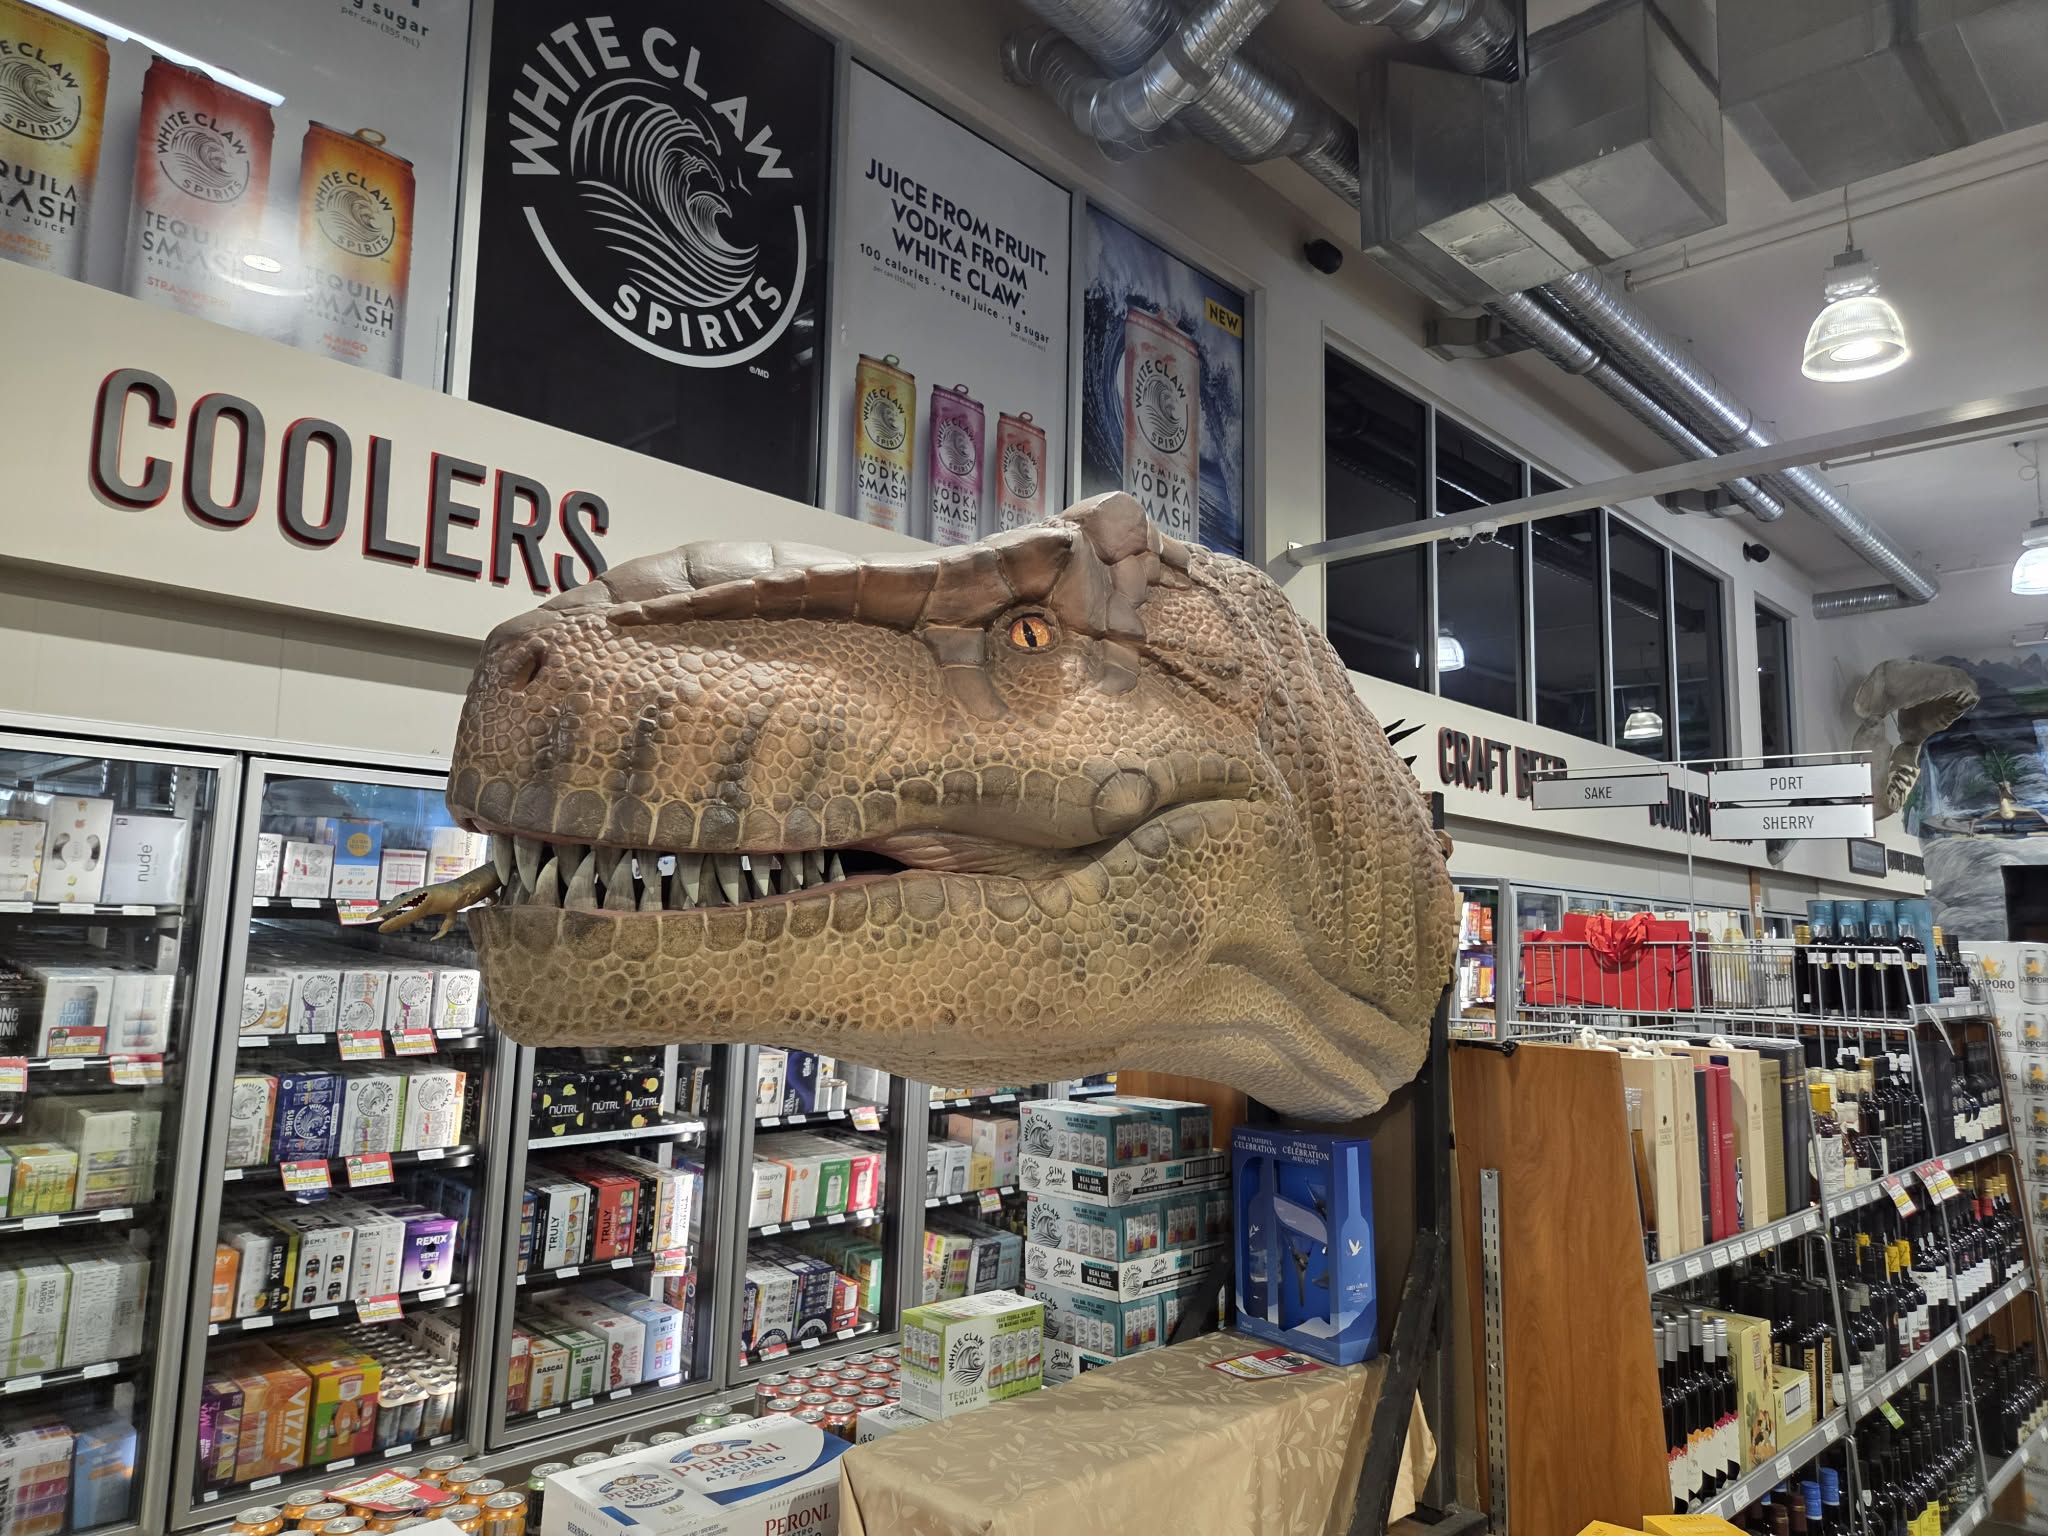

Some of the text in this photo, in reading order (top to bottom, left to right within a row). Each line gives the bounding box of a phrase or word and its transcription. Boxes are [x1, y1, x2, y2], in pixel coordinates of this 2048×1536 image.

[341, 6, 358, 17] per
[360, 16, 378, 27] can
[380, 23, 400, 38] (355
[372, 3, 430, 37] sugar
[16, 41, 79, 89] CLAW
[508, 15, 793, 178] WHITE CLAW
[3, 115, 73, 137] SPIRITS
[157, 111, 247, 155] WHITE CLAW
[182, 179, 243, 200] SPIRITS
[315, 171, 392, 213] WHITE CLAW
[23, 216, 66, 234] JUICE
[865, 158, 1049, 276] JUICE FROM FRUIT.
[336, 235, 390, 253] SPIRITS
[891, 198, 1028, 290] VODKA FROM
[892, 227, 962, 283] WHITE
[306, 265, 394, 310] TEQUILA
[859, 242, 881, 261] 100
[885, 256, 931, 286] calories
[950, 288, 970, 305] real
[973, 296, 999, 319] juice
[1024, 322, 1050, 344] sugar
[304, 285, 393, 330] SMASH
[613, 276, 782, 350] SPIRITS
[1209, 304, 1239, 331] NEW
[354, 323, 387, 338] JUICE
[1135, 359, 1186, 408] WHITE CLAW
[864, 389, 905, 421] WHITE CLAW
[875, 433, 904, 450] SPIRITS
[937, 418, 975, 448] WHITE CLAW
[1151, 426, 1185, 449] SPIRITS
[864, 452, 903, 471] PREMIUM
[948, 460, 975, 476] SPIRITS
[1003, 442, 1038, 473] WHITE CLAW
[91, 368, 609, 596] COOLERS
[859, 460, 906, 486] VODKA
[1137, 459, 1186, 485] PREMIUM
[858, 476, 907, 502] SMASH
[933, 486, 977, 510] VODKA
[1013, 482, 1037, 498] SPIRITS
[1131, 469, 1190, 509] VODKA
[932, 500, 977, 526] SMASH
[1132, 491, 1190, 533] MASH
[1438, 727, 1511, 797] CRAFT
[1584, 786, 1612, 800] SAKE
[1769, 776, 1804, 791] PORT
[1763, 815, 1815, 831] SHERRY
[137, 844, 153, 882] nude
[245, 984, 265, 998] LAW
[372, 1081, 394, 1114] WHITE CLAW
[432, 1076, 453, 1109] WHITE CLAW
[309, 1104, 330, 1115] WHITE
[285, 1110, 295, 1137] SURGE
[1024, 1117, 1035, 1142] WHITE
[1036, 1115, 1053, 1131] CLAW
[1234, 1141, 1277, 1155] CELEBRATION
[1282, 1145, 1329, 1161] CÉLÉBRATION
[1049, 1166, 1062, 1176] GIN
[601, 1210, 611, 1244] TRULY
[1031, 1204, 1042, 1229] WHITE
[1043, 1203, 1060, 1220] CLAW
[416, 1234, 449, 1246] REMIX
[549, 1216, 560, 1251] TRULY
[1057, 1257, 1072, 1267] GIN
[1089, 1268, 1100, 1276] REAL
[1087, 1276, 1098, 1284] REAL
[1122, 1264, 1142, 1287] WHITE CLAW
[576, 1354, 601, 1365] RASCAL
[949, 1333, 985, 1371] WHITE CLAW
[1055, 1349, 1069, 1360] GIN
[1824, 1341, 1832, 1388] Malivoire
[537, 1363, 563, 1374] RASCAL
[948, 1386, 984, 1401] TEQUILA
[955, 1397, 978, 1407] SMASH
[280, 1387, 308, 1467] VIZZY
[671, 1442, 782, 1478] PERONI
[706, 1456, 786, 1482] AZZURRO
[710, 1456, 766, 1474] NASTRO
[604, 1478, 673, 1500] PERONI
[765, 1502, 831, 1536] PERONI
